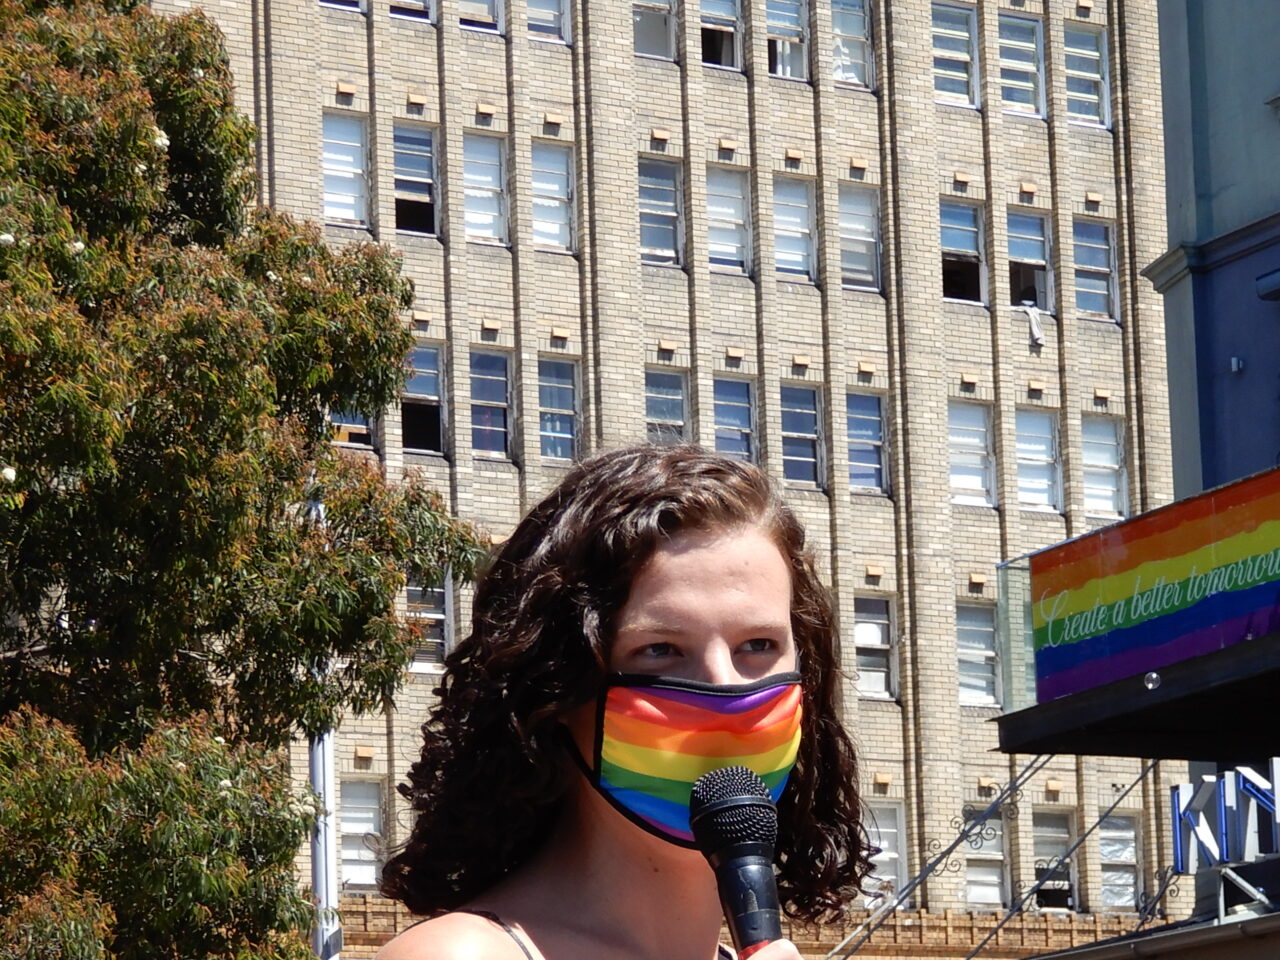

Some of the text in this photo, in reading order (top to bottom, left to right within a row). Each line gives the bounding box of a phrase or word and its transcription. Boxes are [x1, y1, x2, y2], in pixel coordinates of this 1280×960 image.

[1041, 588, 1108, 648] Create
[1113, 604, 1127, 625] a
[1131, 576, 1186, 620] better
